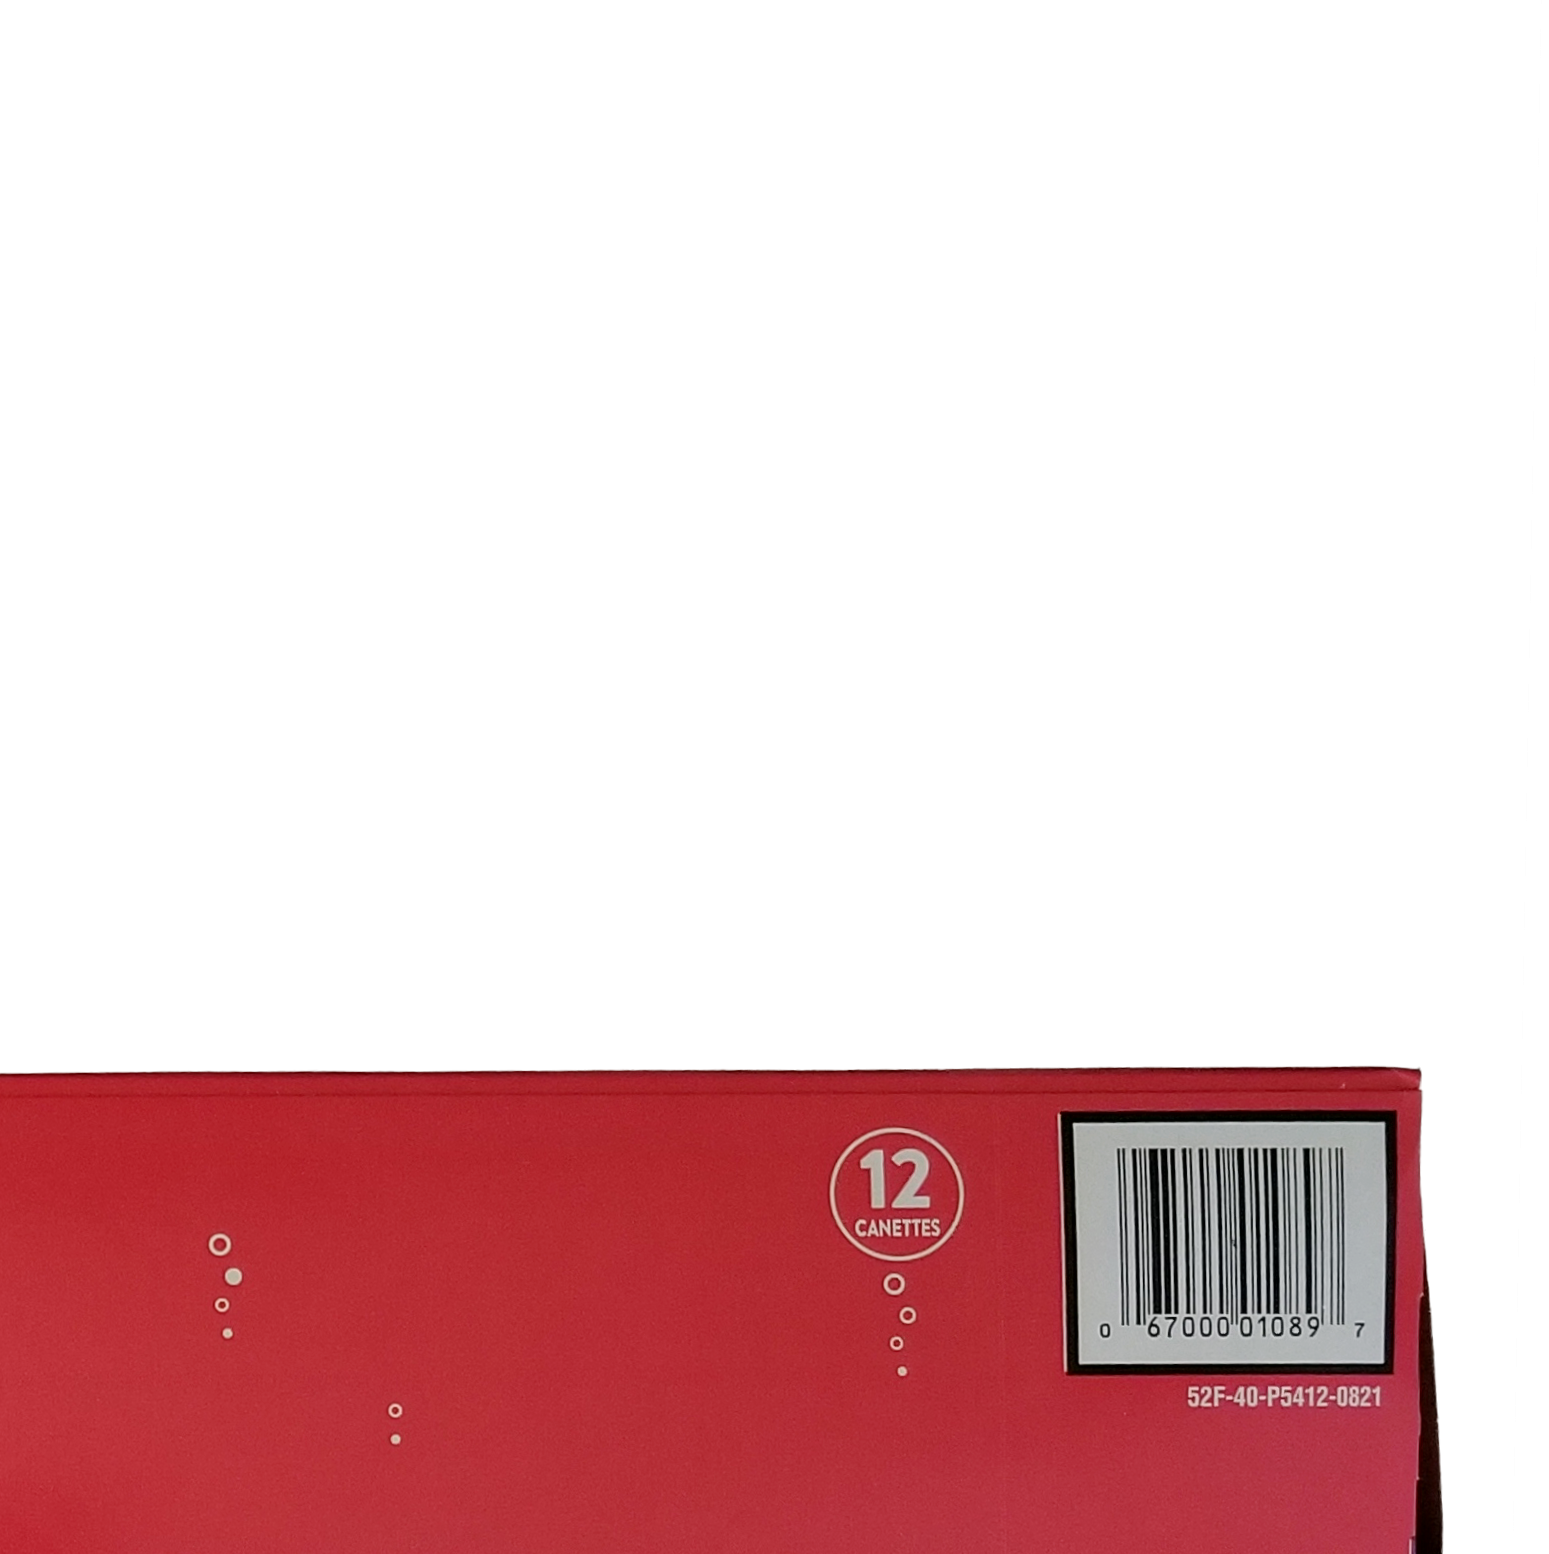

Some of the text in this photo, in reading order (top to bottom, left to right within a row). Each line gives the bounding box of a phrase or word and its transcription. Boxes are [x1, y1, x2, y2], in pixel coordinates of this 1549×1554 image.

[860, 1148, 931, 1209] 12
[855, 1219, 941, 1238] CANETTES
[1100, 1323, 1110, 1338] 0
[1354, 1323, 1364, 1338] 7
[1187, 1386, 1381, 1407] 52F-40-P5412-0821
